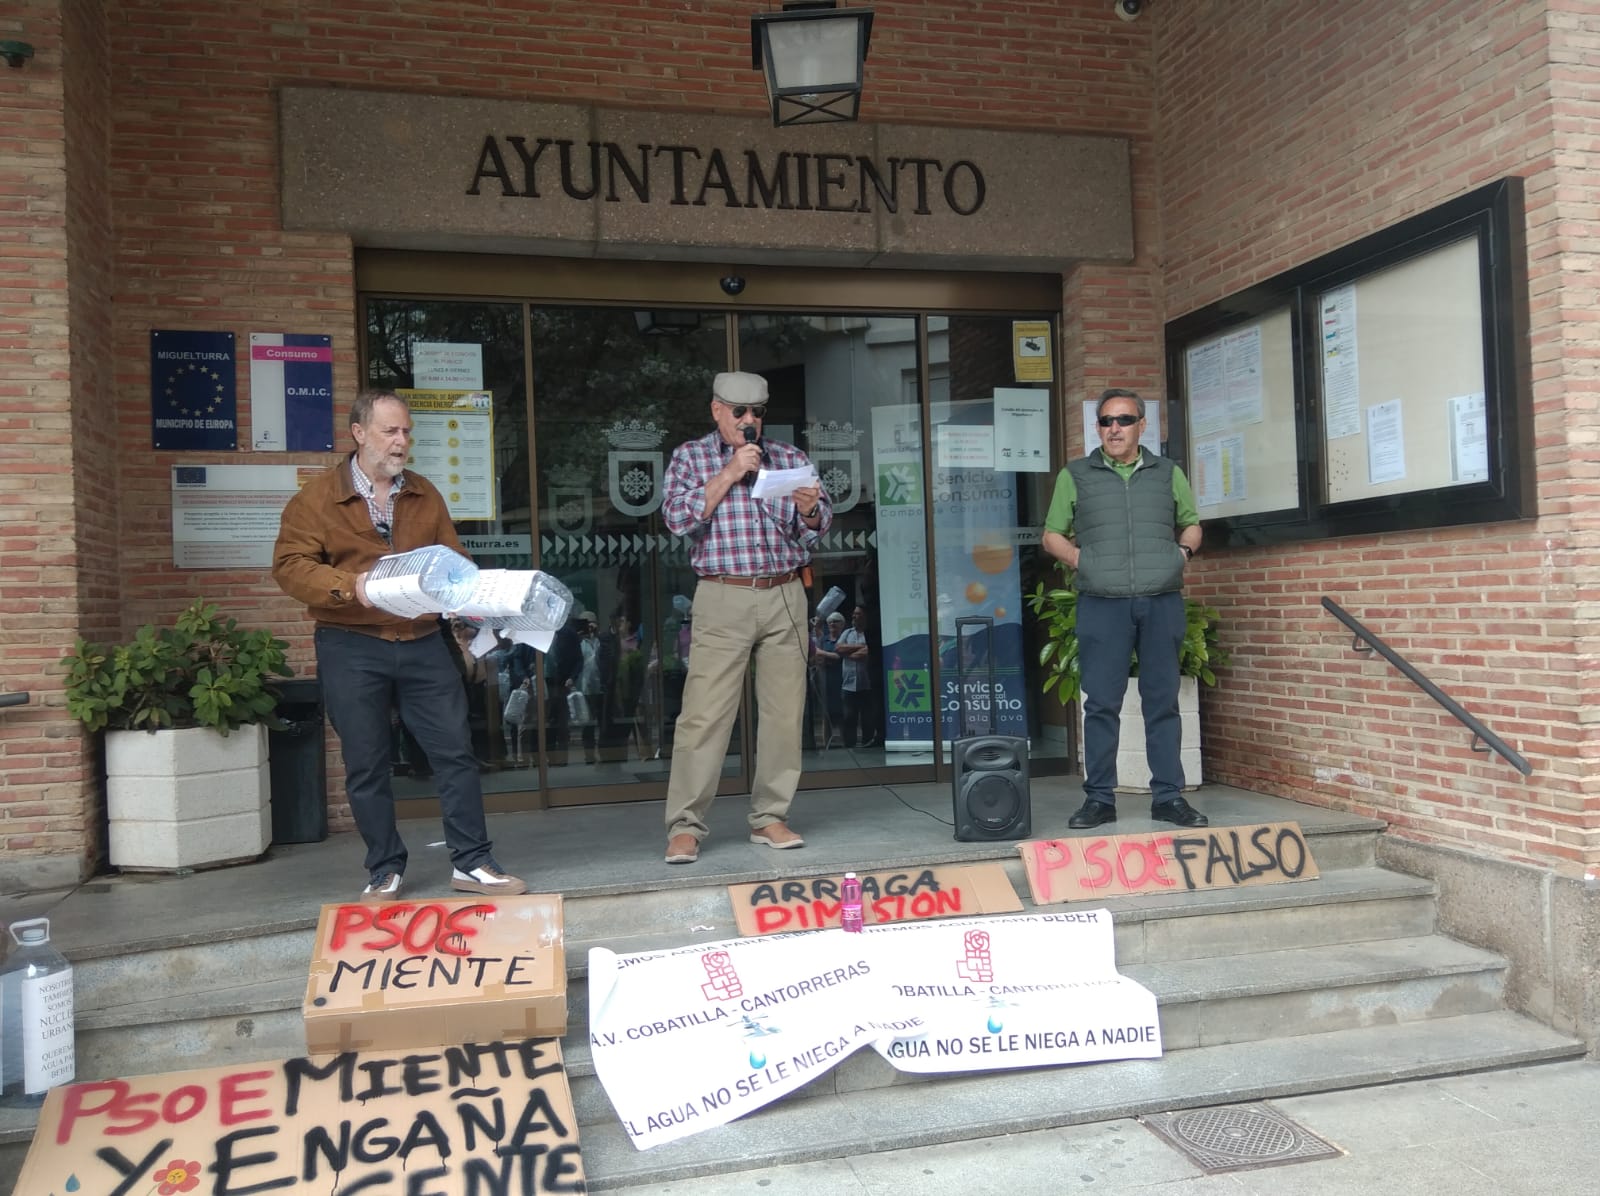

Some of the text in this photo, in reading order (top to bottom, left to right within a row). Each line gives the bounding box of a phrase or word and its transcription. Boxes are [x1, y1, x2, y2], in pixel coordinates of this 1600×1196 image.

[465, 136, 987, 216] AYUNTAMIENTO
[157, 351, 230, 361] MIGUELTURRA
[266, 349, 318, 359] Consumo
[287, 387, 331, 397] O.M.I.C.
[155, 418, 234, 430] MUNICIPIO DE EUROPA
[946, 680, 1004, 694] Servico
[1032, 827, 1306, 901] PSOE FALSO
[328, 902, 498, 957] PSOE
[754, 888, 962, 934] DIMSION
[329, 955, 535, 993] MIENTE
[626, 1006, 729, 1041] COBATILLA
[740, 960, 871, 1013] CANTORRERAS
[887, 1025, 1156, 1059] GUA NO SE LE NIEGA A NADIE
[56, 1037, 564, 1146] PSOE MIENTE
[647, 1102, 700, 1133] AGUA
[701, 1087, 732, 1113] NO
[736, 1073, 763, 1098] SE
[765, 1060, 791, 1085] LE
[792, 1036, 850, 1073] NIEGA
[854, 1024, 867, 1037] A
[207, 1086, 569, 1196] ENGAÑA
